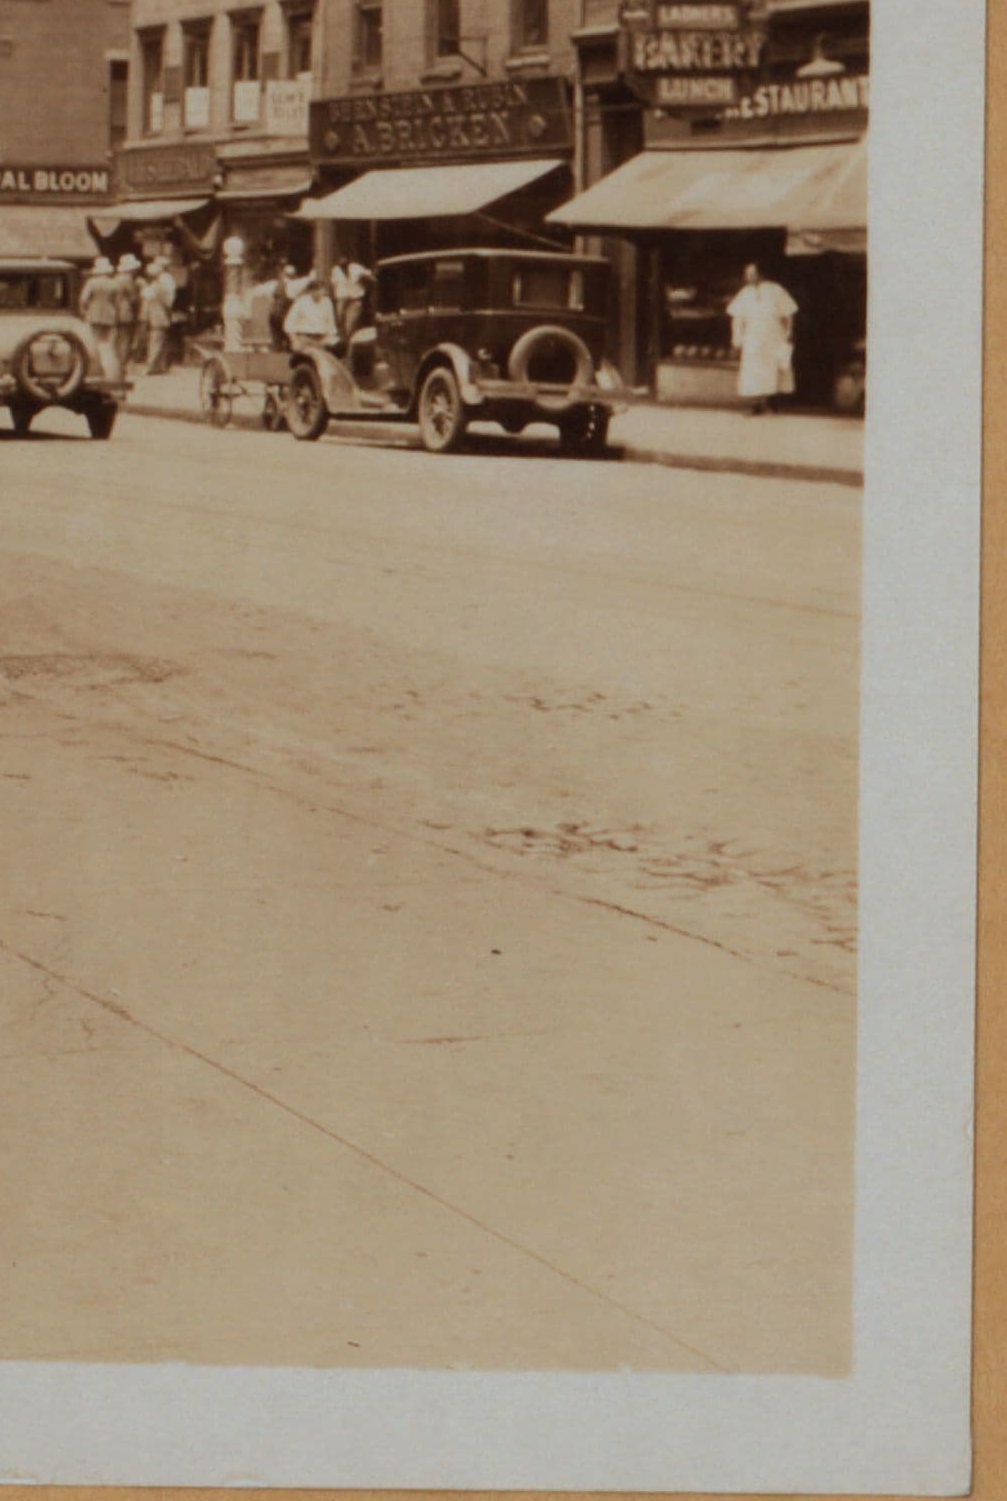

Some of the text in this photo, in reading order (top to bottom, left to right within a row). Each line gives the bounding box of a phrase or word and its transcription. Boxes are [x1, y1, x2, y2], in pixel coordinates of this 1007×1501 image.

[634, 31, 766, 69] BAKERY
[661, 78, 730, 99] LUNCH
[34, 170, 108, 193] BLOOM
